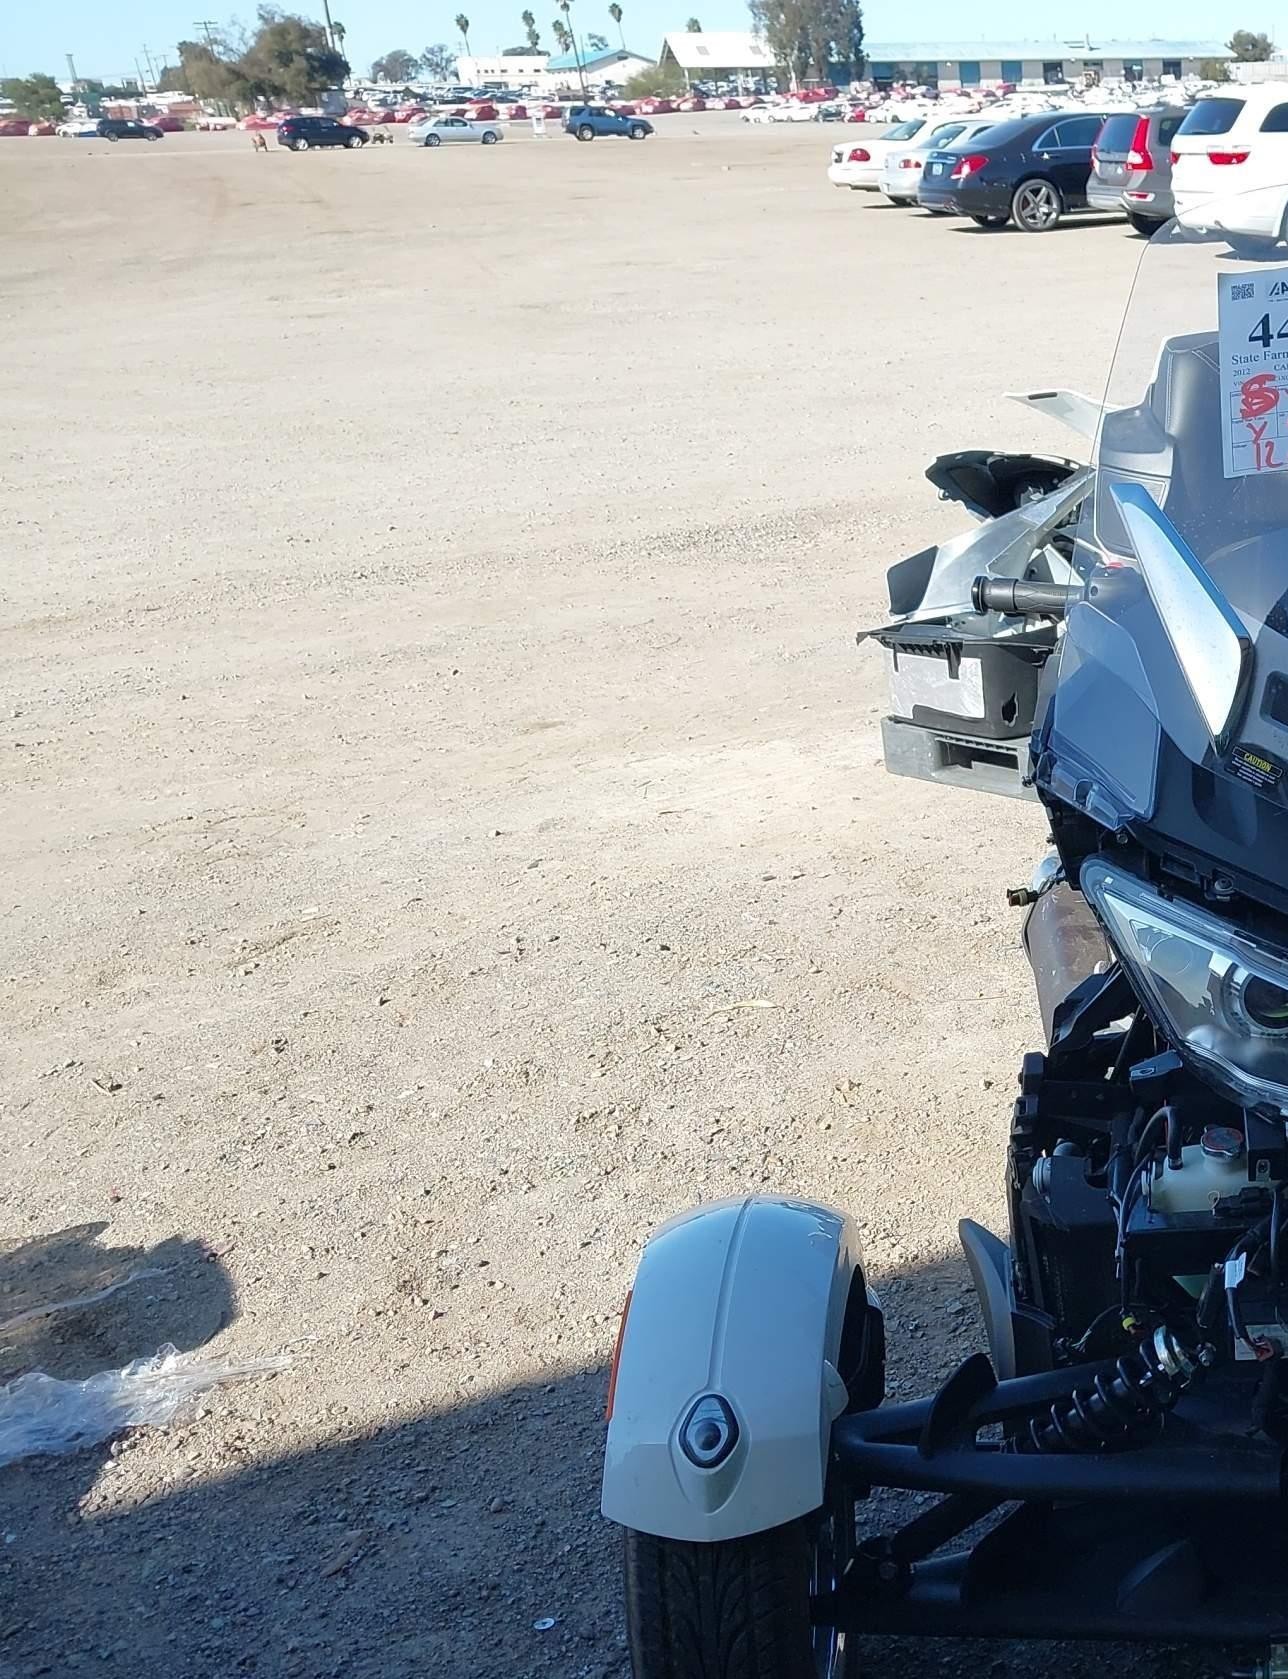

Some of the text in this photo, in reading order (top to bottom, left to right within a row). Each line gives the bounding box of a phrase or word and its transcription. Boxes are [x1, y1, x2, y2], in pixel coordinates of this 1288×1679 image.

[1231, 353, 1260, 366] State
[1233, 368, 1251, 377] 2012
[1243, 753, 1272, 772] CAUTION
